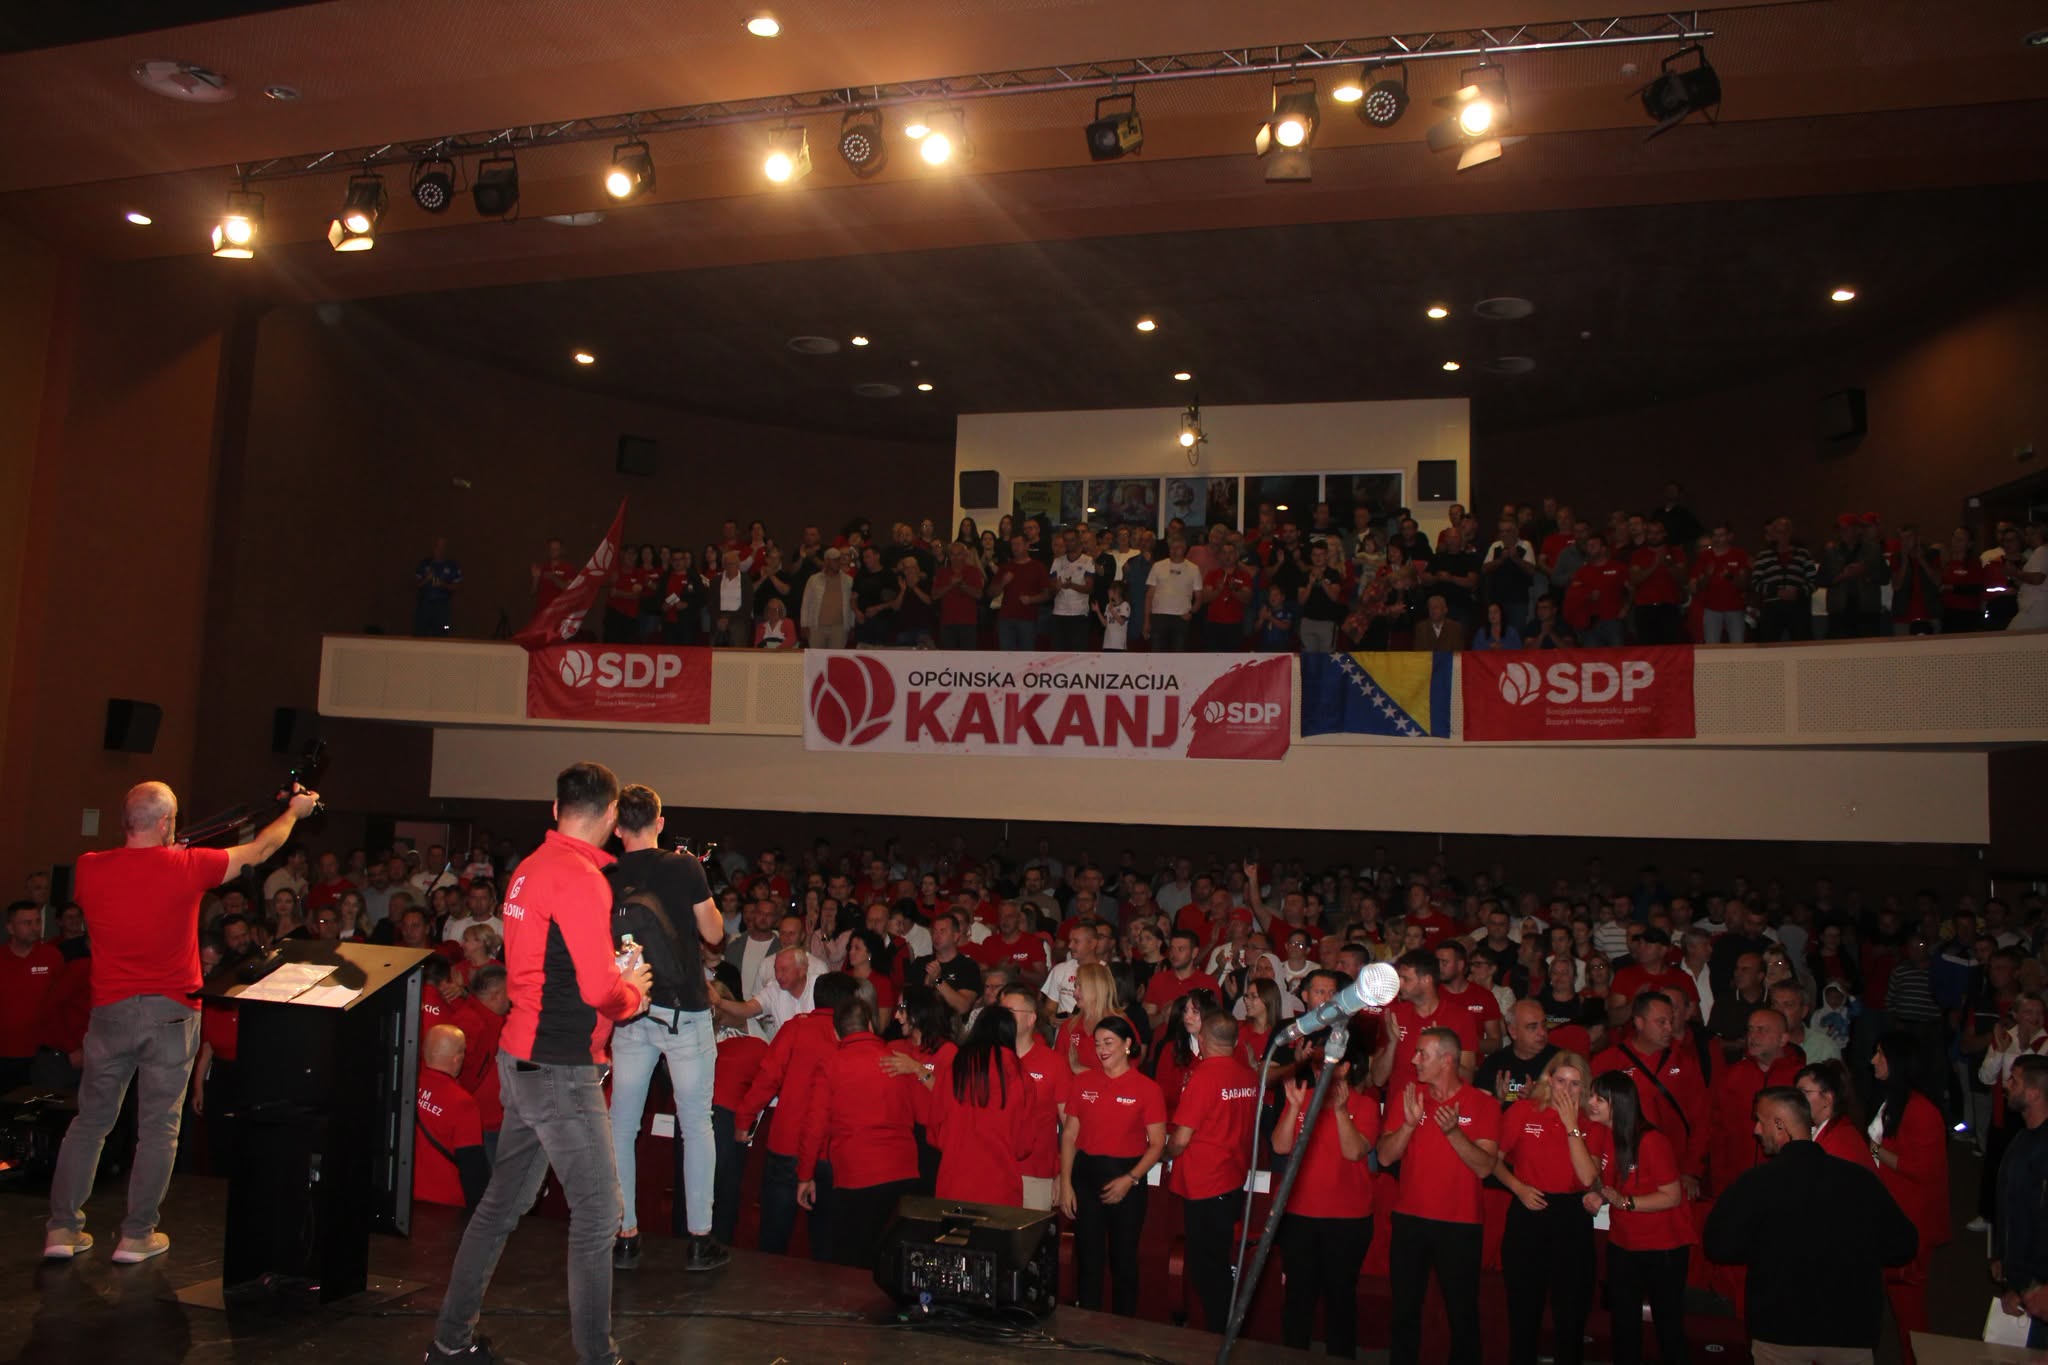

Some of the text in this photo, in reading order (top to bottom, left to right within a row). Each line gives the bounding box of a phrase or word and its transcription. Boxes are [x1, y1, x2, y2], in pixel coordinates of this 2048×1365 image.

[596, 652, 682, 688] SDP
[908, 668, 1179, 690] OPĆINSKA ORGANIZACIJA
[1546, 661, 1655, 704] SDP
[905, 691, 1180, 748] KAKANJ
[1227, 702, 1281, 724] SDP
